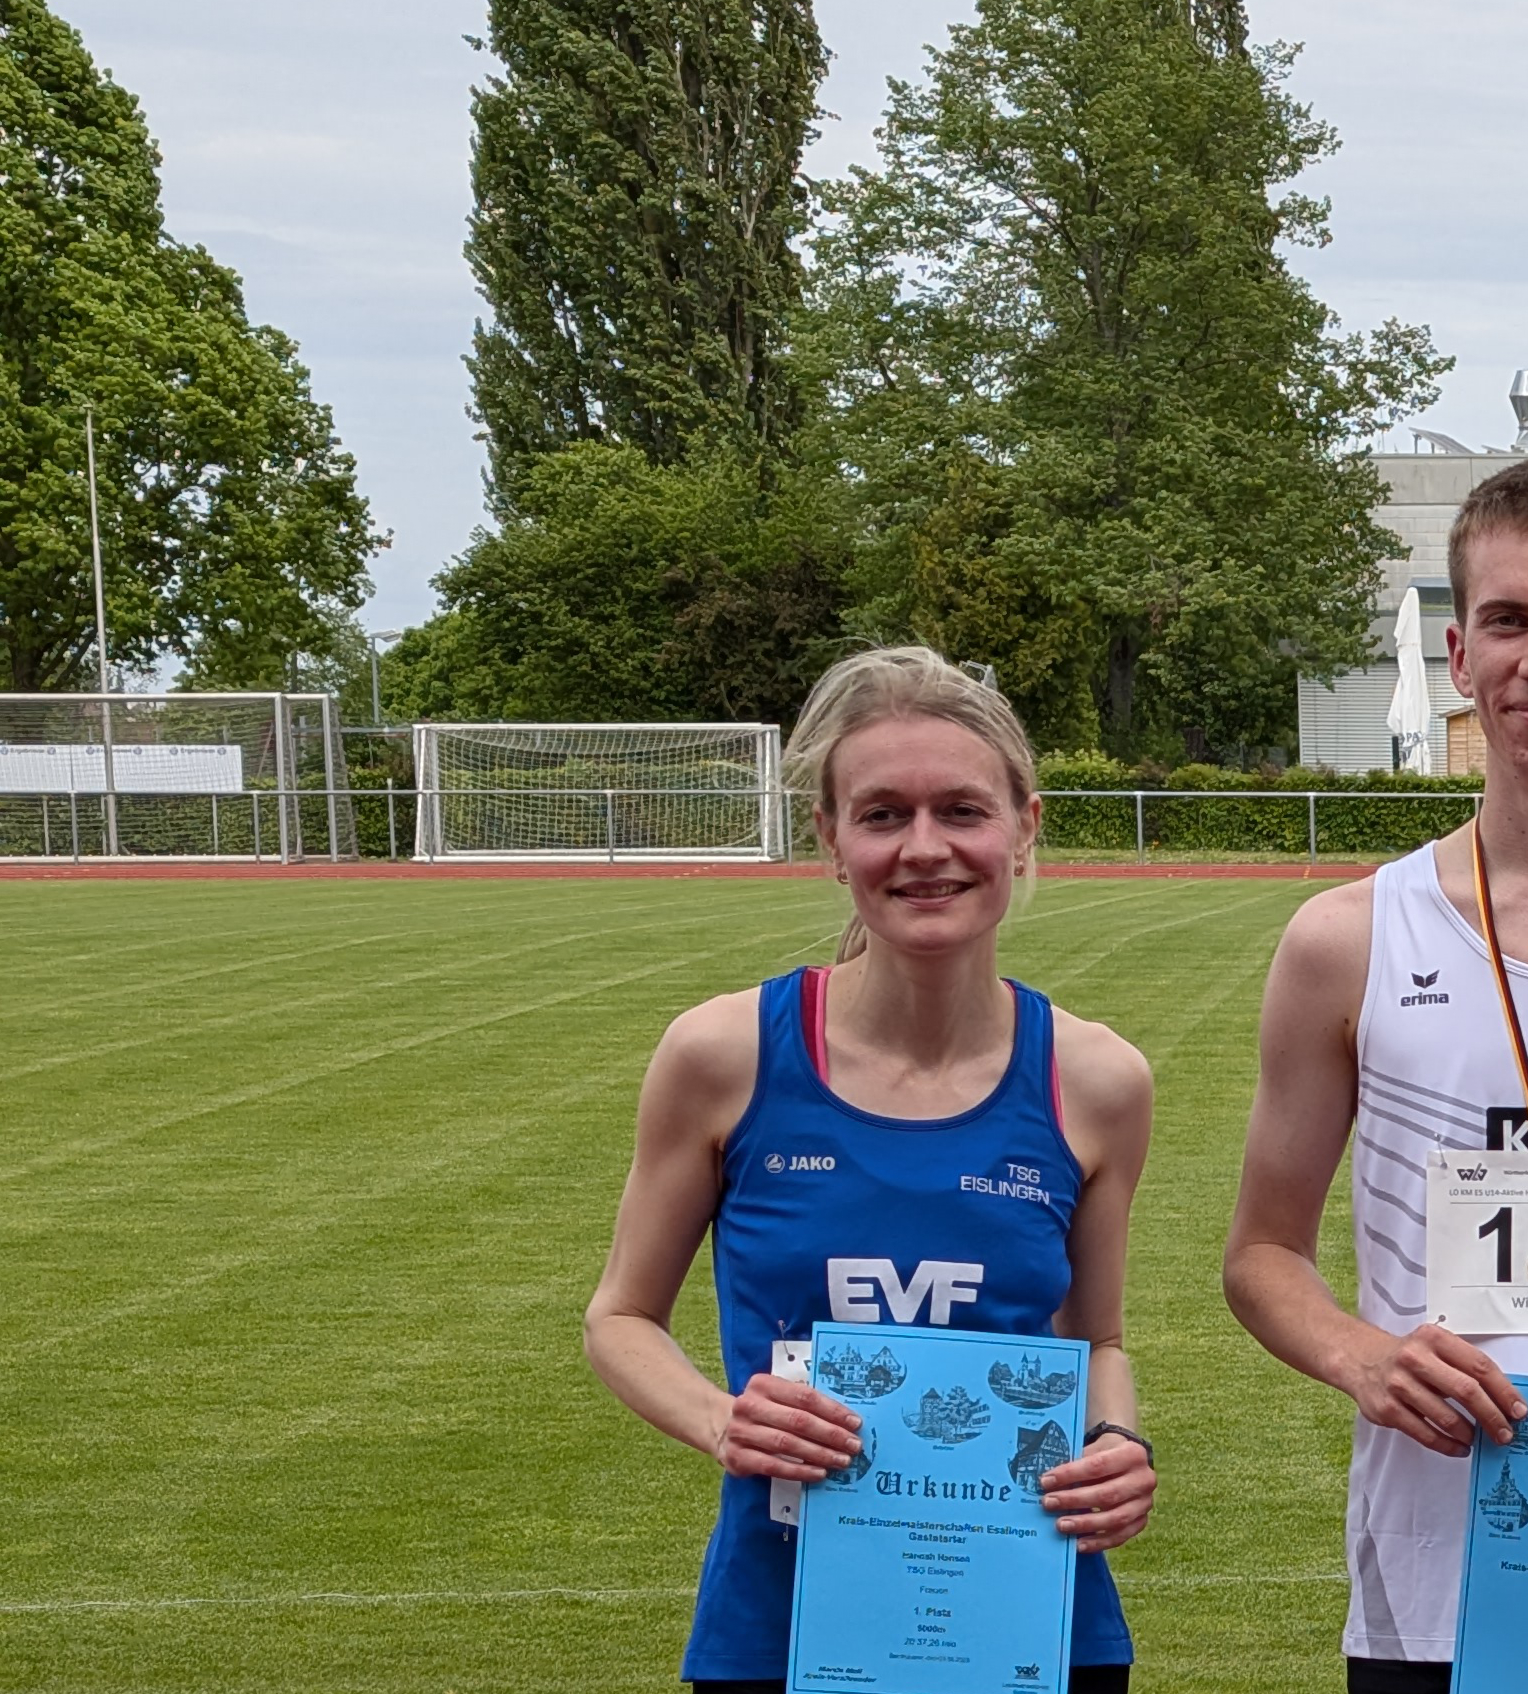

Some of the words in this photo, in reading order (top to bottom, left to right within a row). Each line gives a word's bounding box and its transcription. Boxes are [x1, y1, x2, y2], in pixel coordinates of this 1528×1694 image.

[1400, 992, 1450, 1007] erima
[789, 1156, 836, 1171] JAKO
[1006, 1162, 1041, 1184] TSG
[960, 1175, 1050, 1205] EISLINGEN
[827, 1258, 984, 1325] EVF
[875, 1470, 1012, 1503] Urkunde
